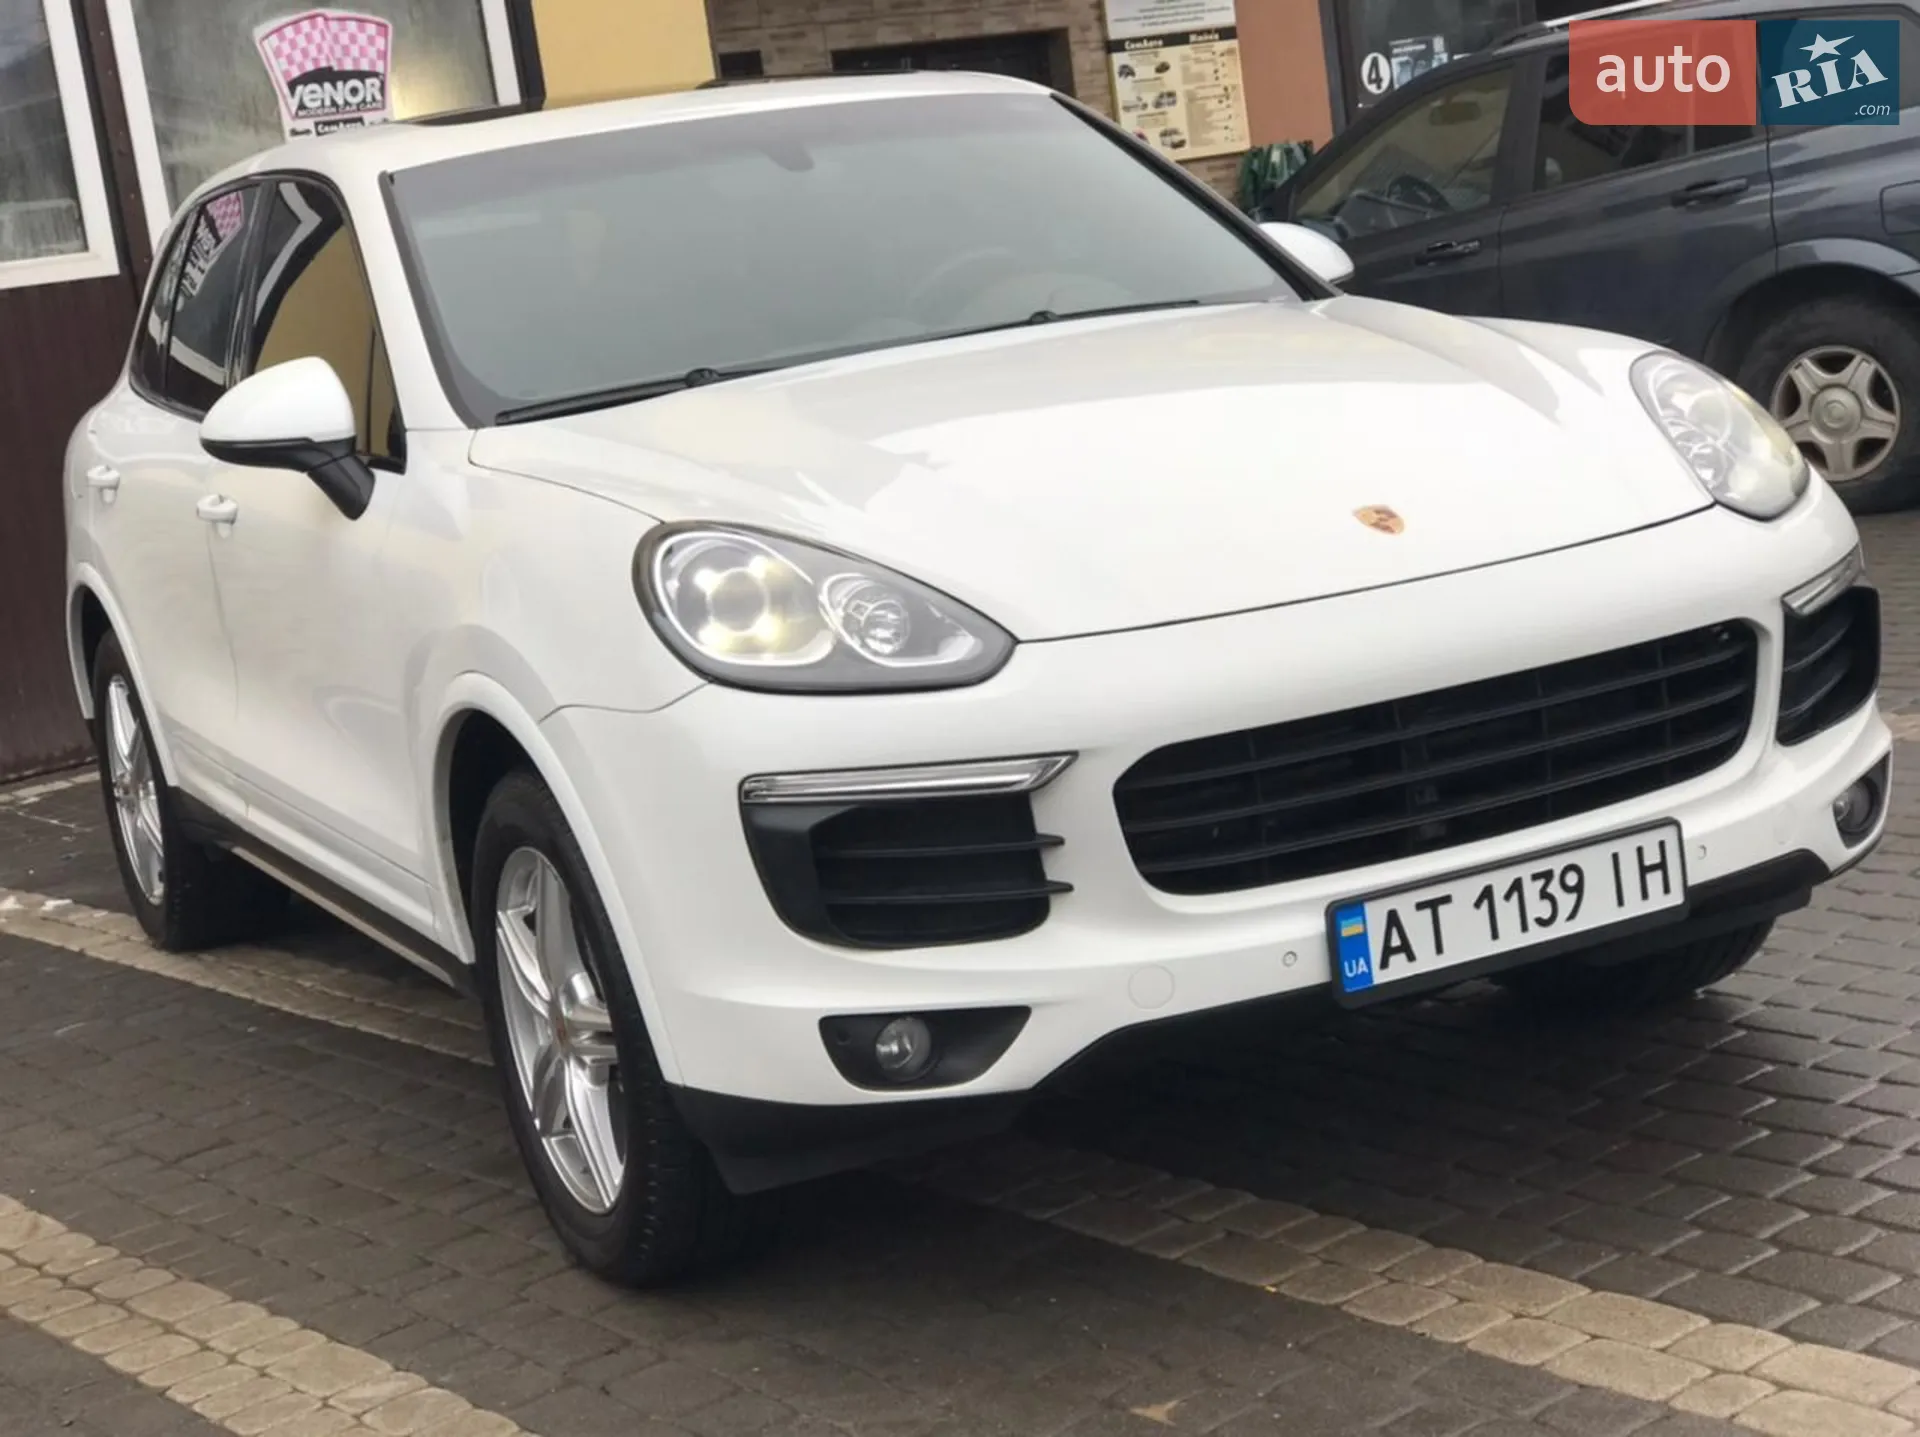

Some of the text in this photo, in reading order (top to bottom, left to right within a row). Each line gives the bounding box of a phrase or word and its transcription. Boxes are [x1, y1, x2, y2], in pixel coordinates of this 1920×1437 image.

[1367, 55, 1383, 91] 4
[1379, 839, 1672, 971] AT 1139 IH
[1343, 959, 1370, 979] UA
